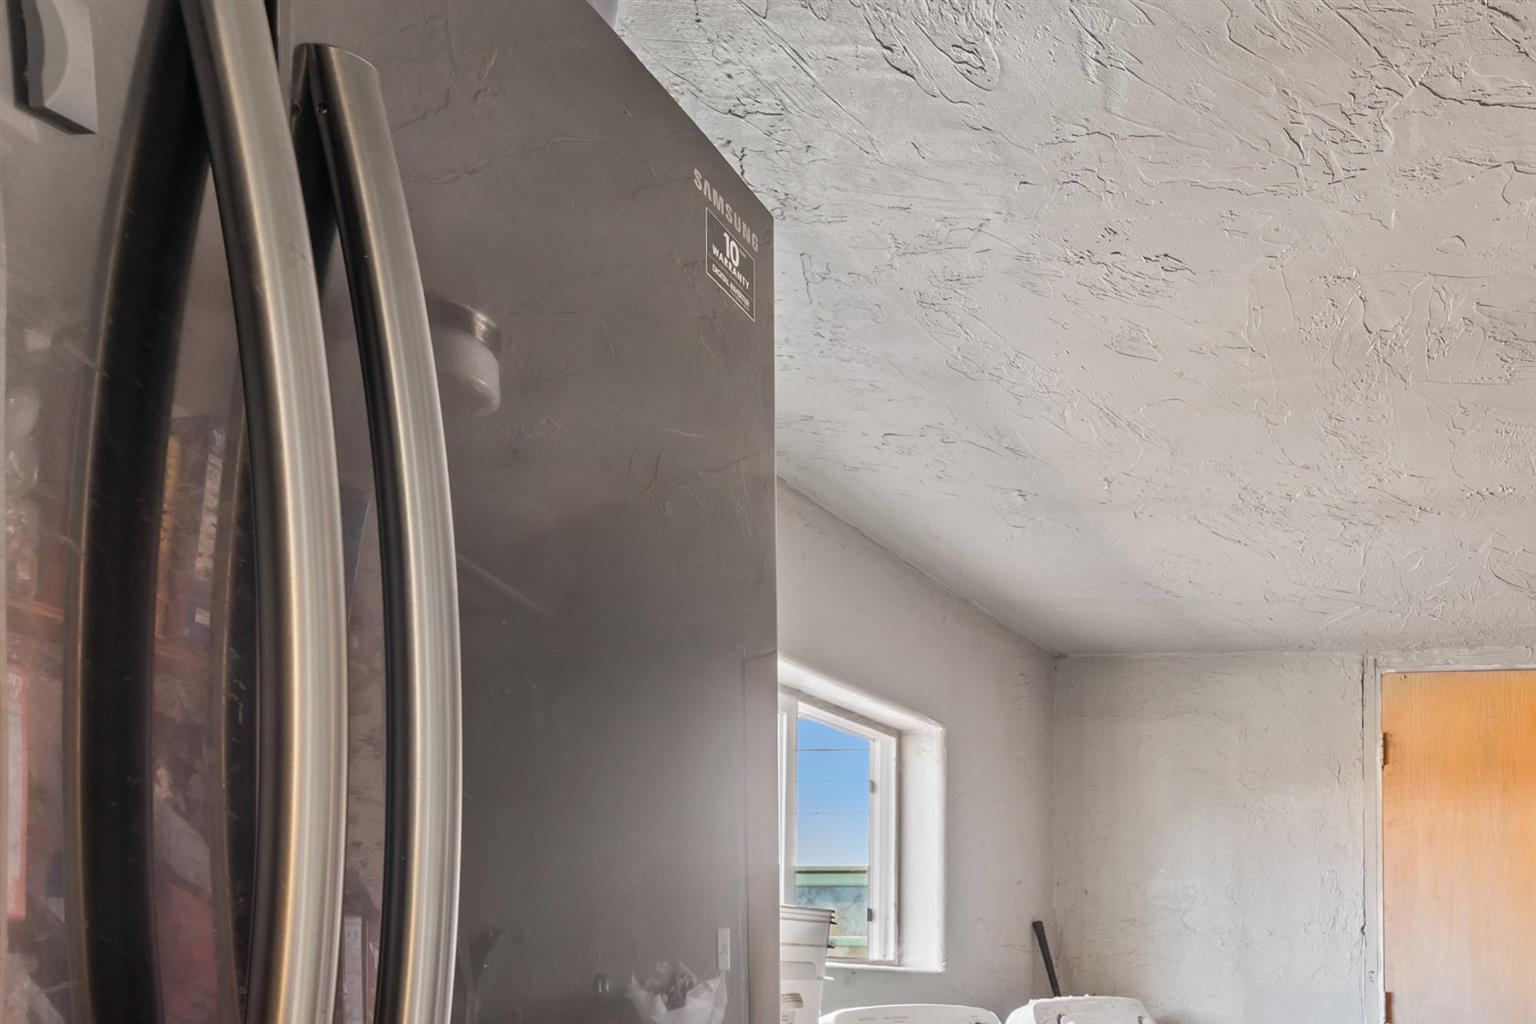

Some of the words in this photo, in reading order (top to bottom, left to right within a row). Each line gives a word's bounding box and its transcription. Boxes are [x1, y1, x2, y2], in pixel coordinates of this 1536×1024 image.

[693, 168, 759, 252] SAMSUNG
[712, 243, 750, 290] WARRANTY
[723, 232, 740, 268] 10
